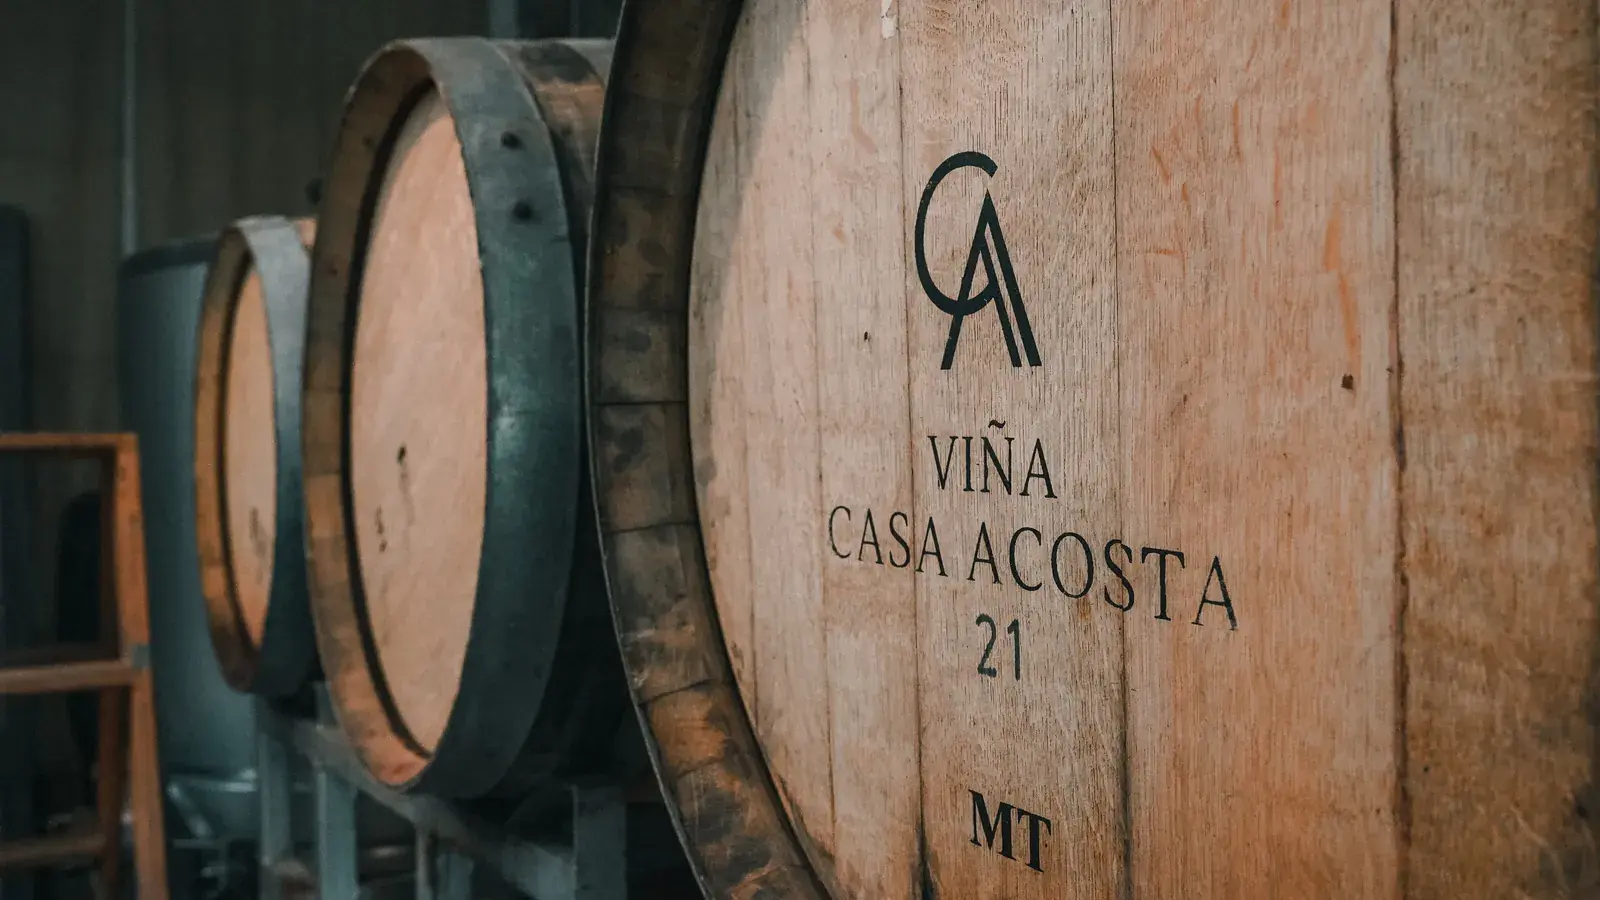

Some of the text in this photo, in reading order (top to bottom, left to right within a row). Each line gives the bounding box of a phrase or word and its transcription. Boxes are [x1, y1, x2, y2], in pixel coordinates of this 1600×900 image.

[928, 420, 1058, 498] VIÑA
[828, 506, 1237, 630] CASA ACOSTA
[975, 613, 1021, 681] 21
[968, 789, 1051, 873] MT
